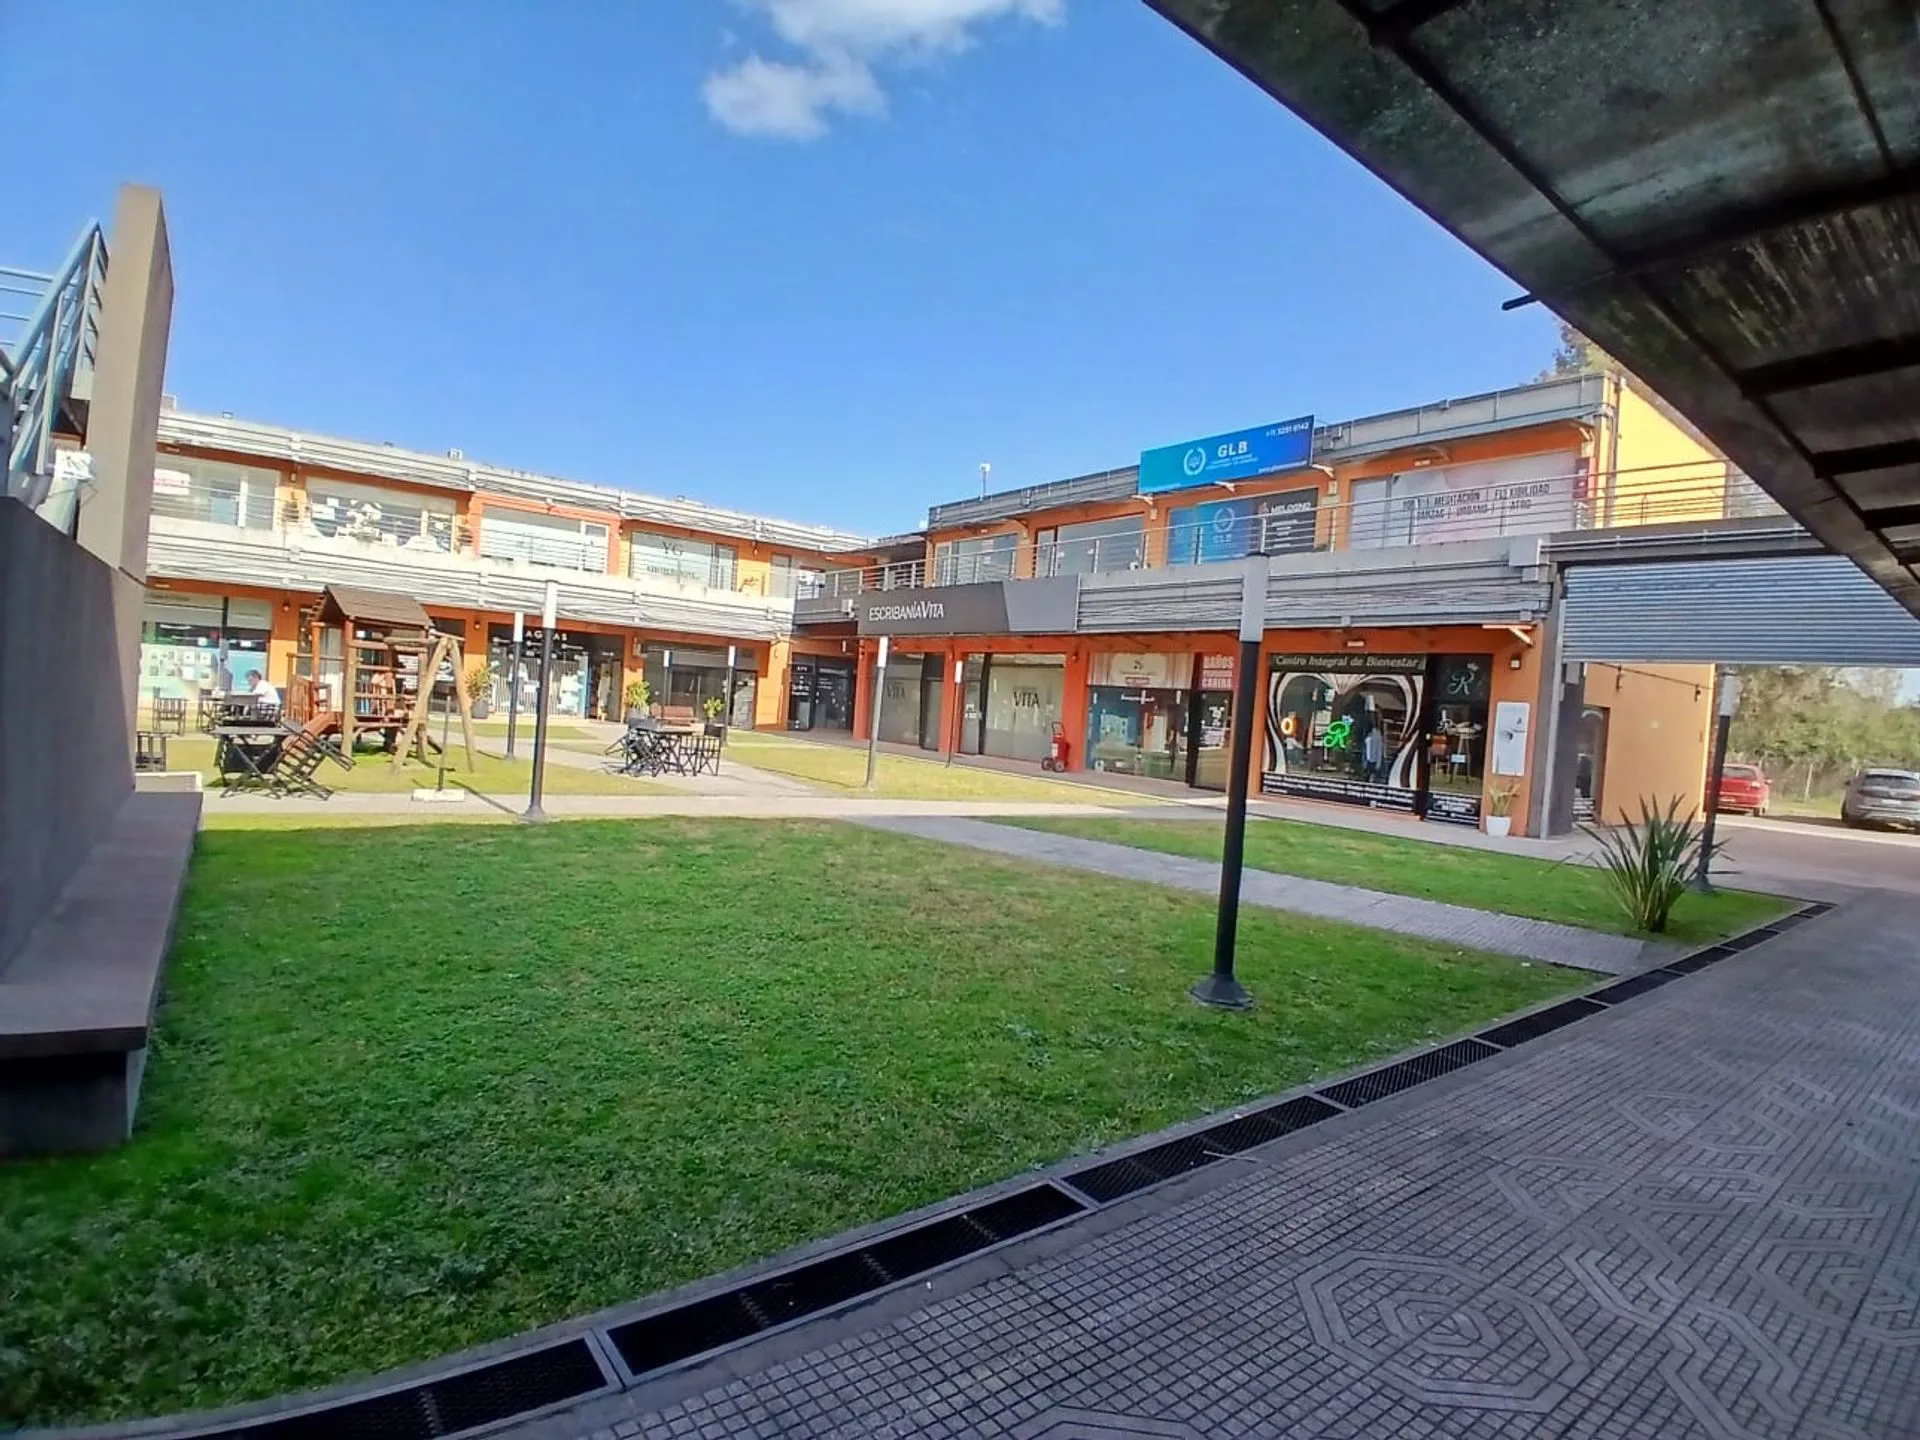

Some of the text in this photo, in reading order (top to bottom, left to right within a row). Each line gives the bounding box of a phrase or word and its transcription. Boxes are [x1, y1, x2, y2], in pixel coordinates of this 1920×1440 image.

[1217, 441, 1248, 458] GLB
[525, 630, 568, 641] AGAS
[1275, 655, 1419, 668] Centro Integral de Bienestar
[1013, 691, 1040, 708] VITA
